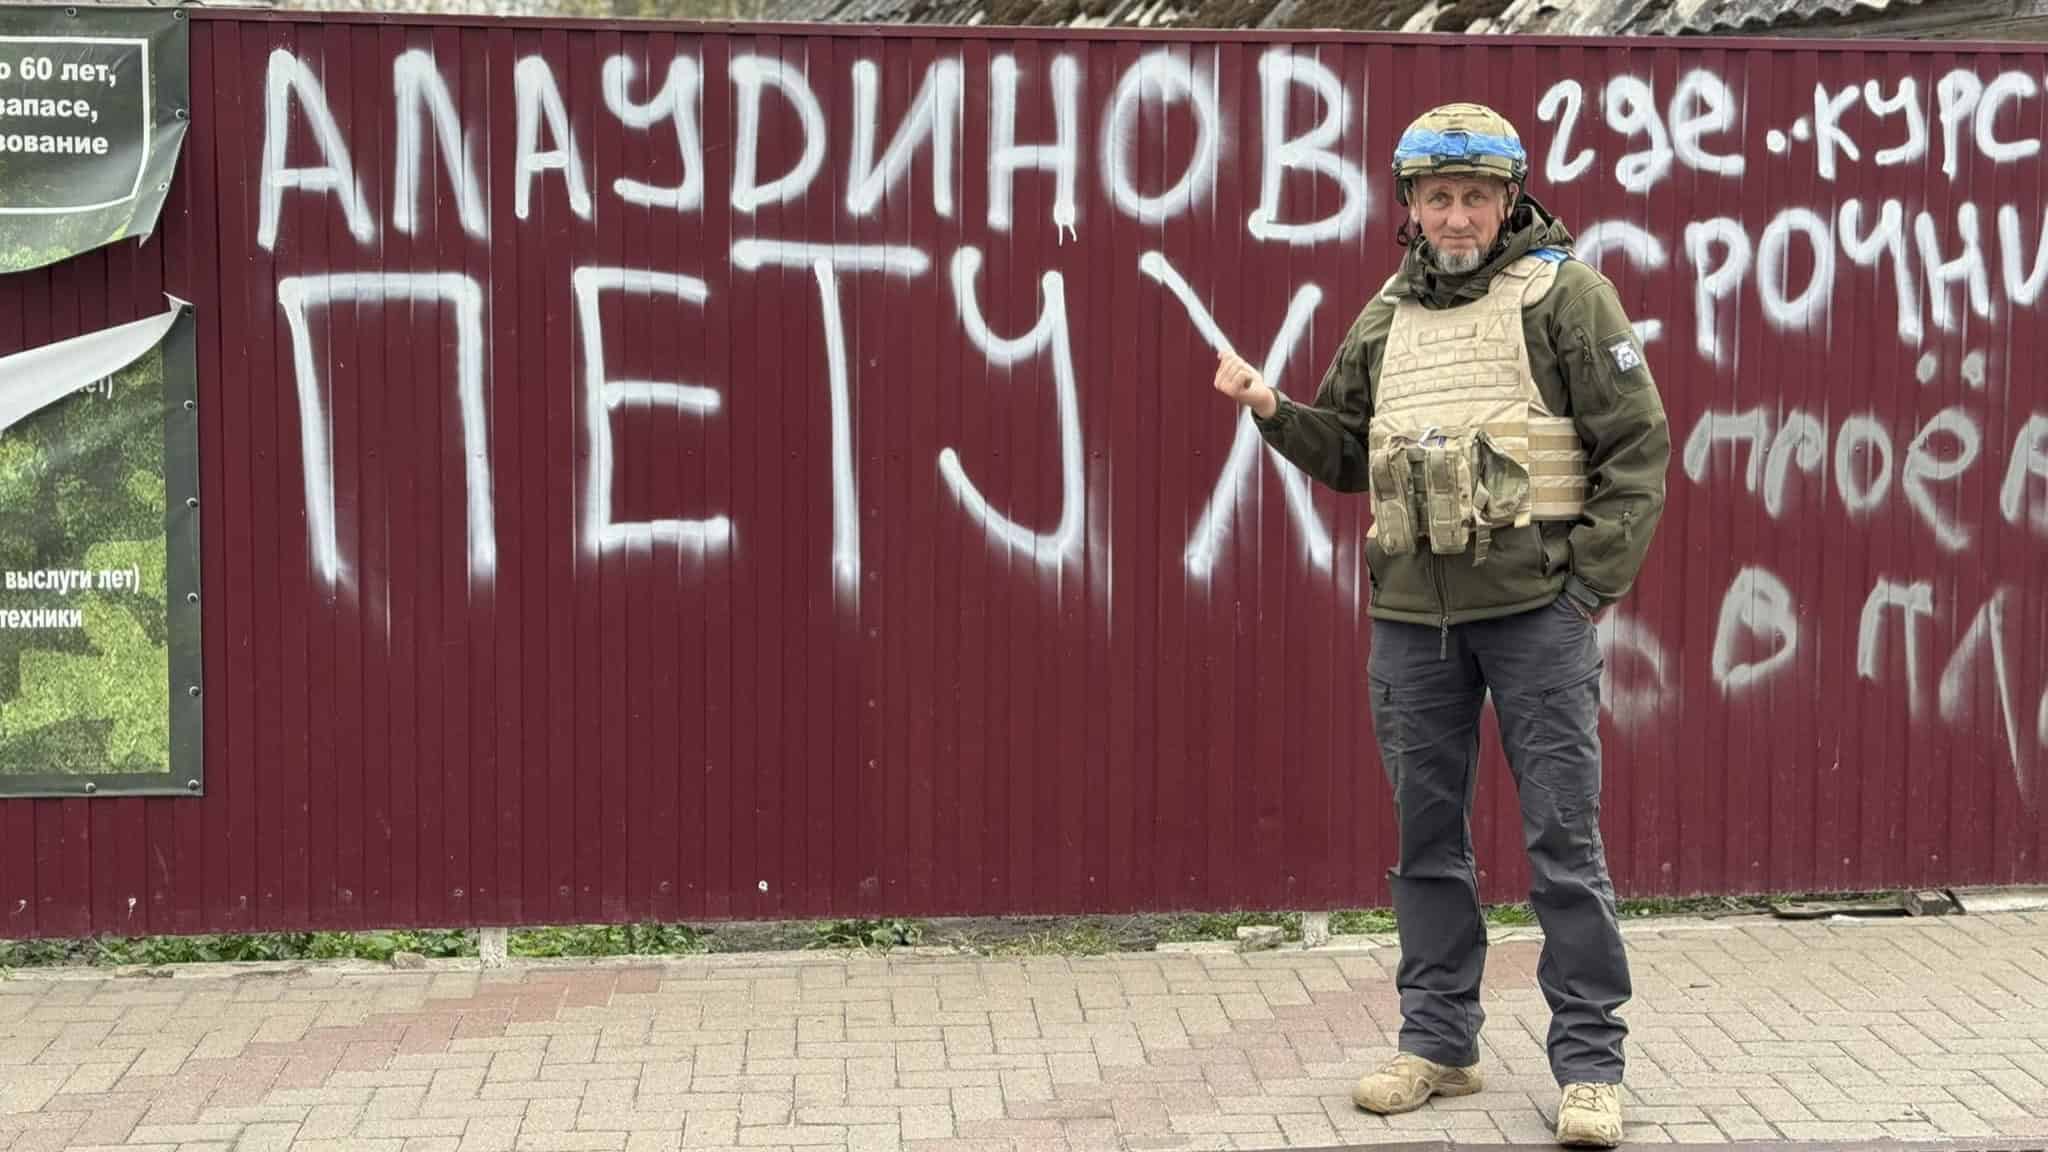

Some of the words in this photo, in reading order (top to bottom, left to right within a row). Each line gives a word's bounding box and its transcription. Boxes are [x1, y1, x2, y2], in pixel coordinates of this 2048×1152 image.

[20, 57, 53, 80] 60
[60, 63, 117, 88] лет,
[276, 238, 1338, 590] ПЕТУХ
[5, 570, 92, 595] выслуги
[98, 562, 140, 594] лет)
[0, 608, 83, 629] техники
